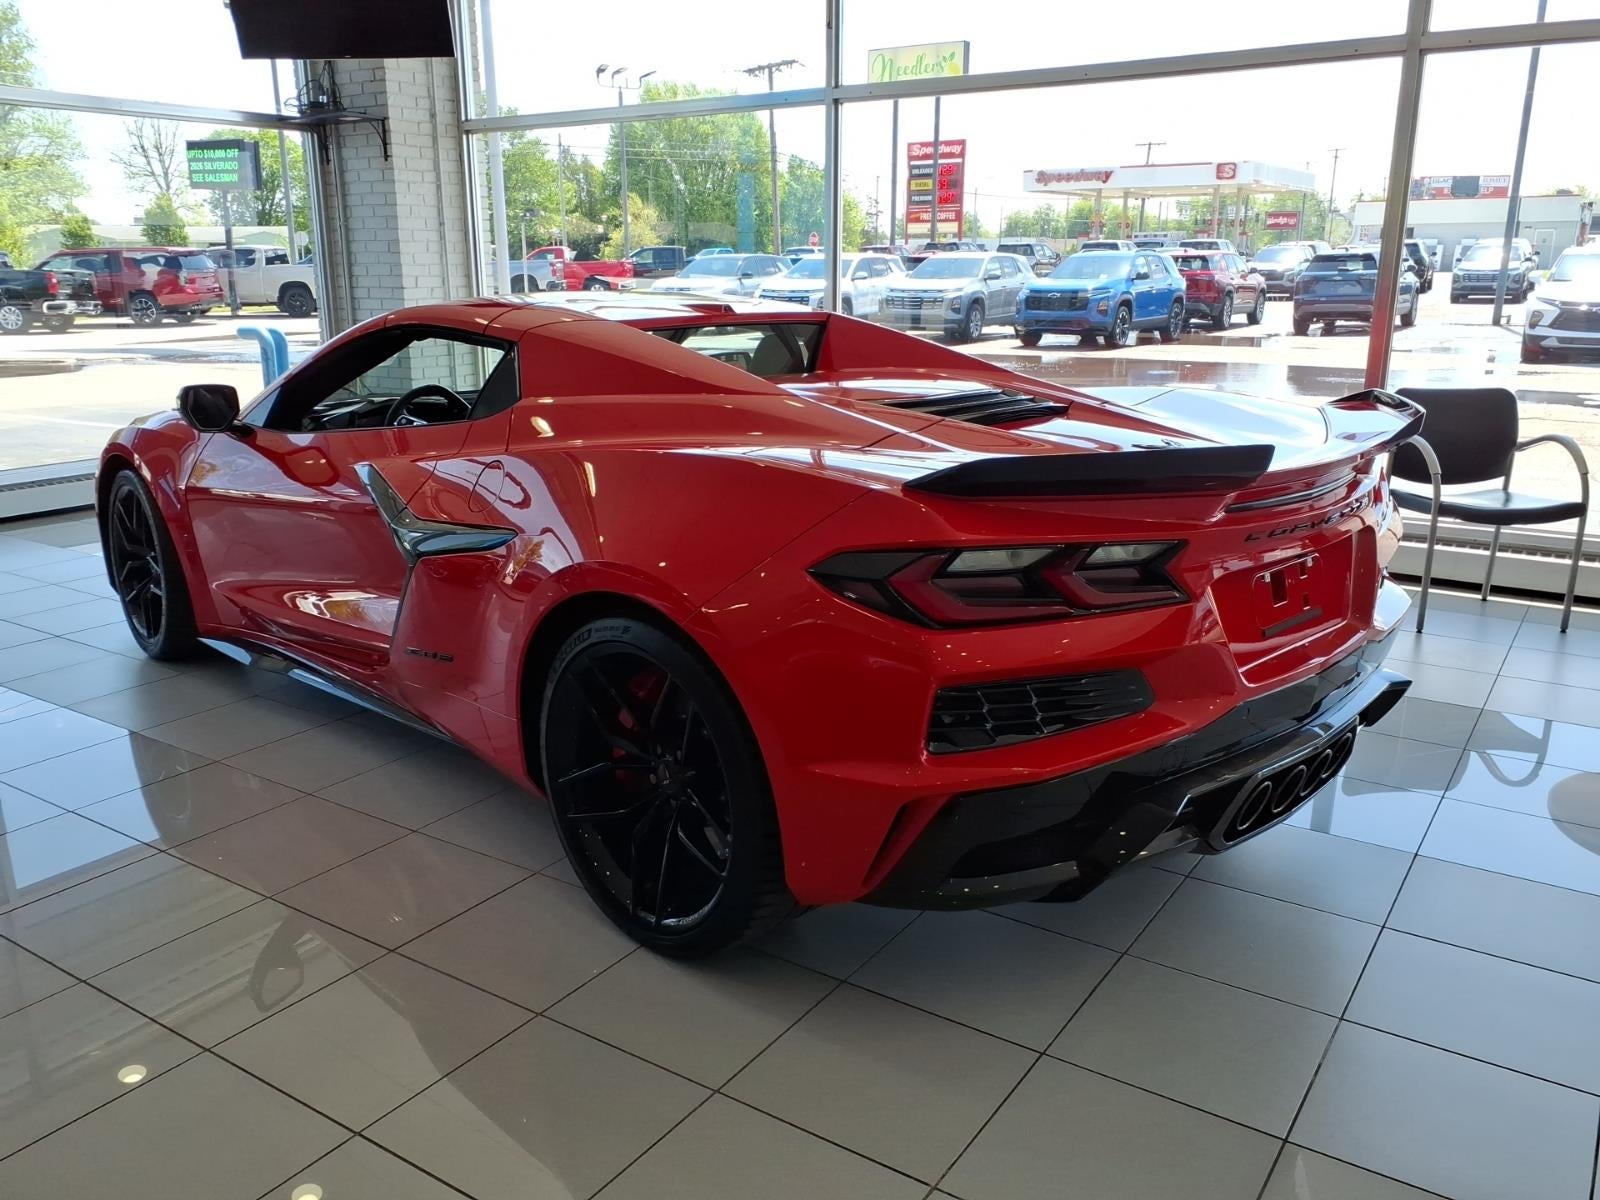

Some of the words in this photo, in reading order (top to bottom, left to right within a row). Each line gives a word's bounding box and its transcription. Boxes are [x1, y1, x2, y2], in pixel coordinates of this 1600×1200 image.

[226, 148, 239, 158] OFF
[911, 143, 963, 156] Spedway
[204, 161, 238, 170] SILVERADO
[192, 173, 204, 182] SEE
[1035, 169, 1114, 186] Speedway
